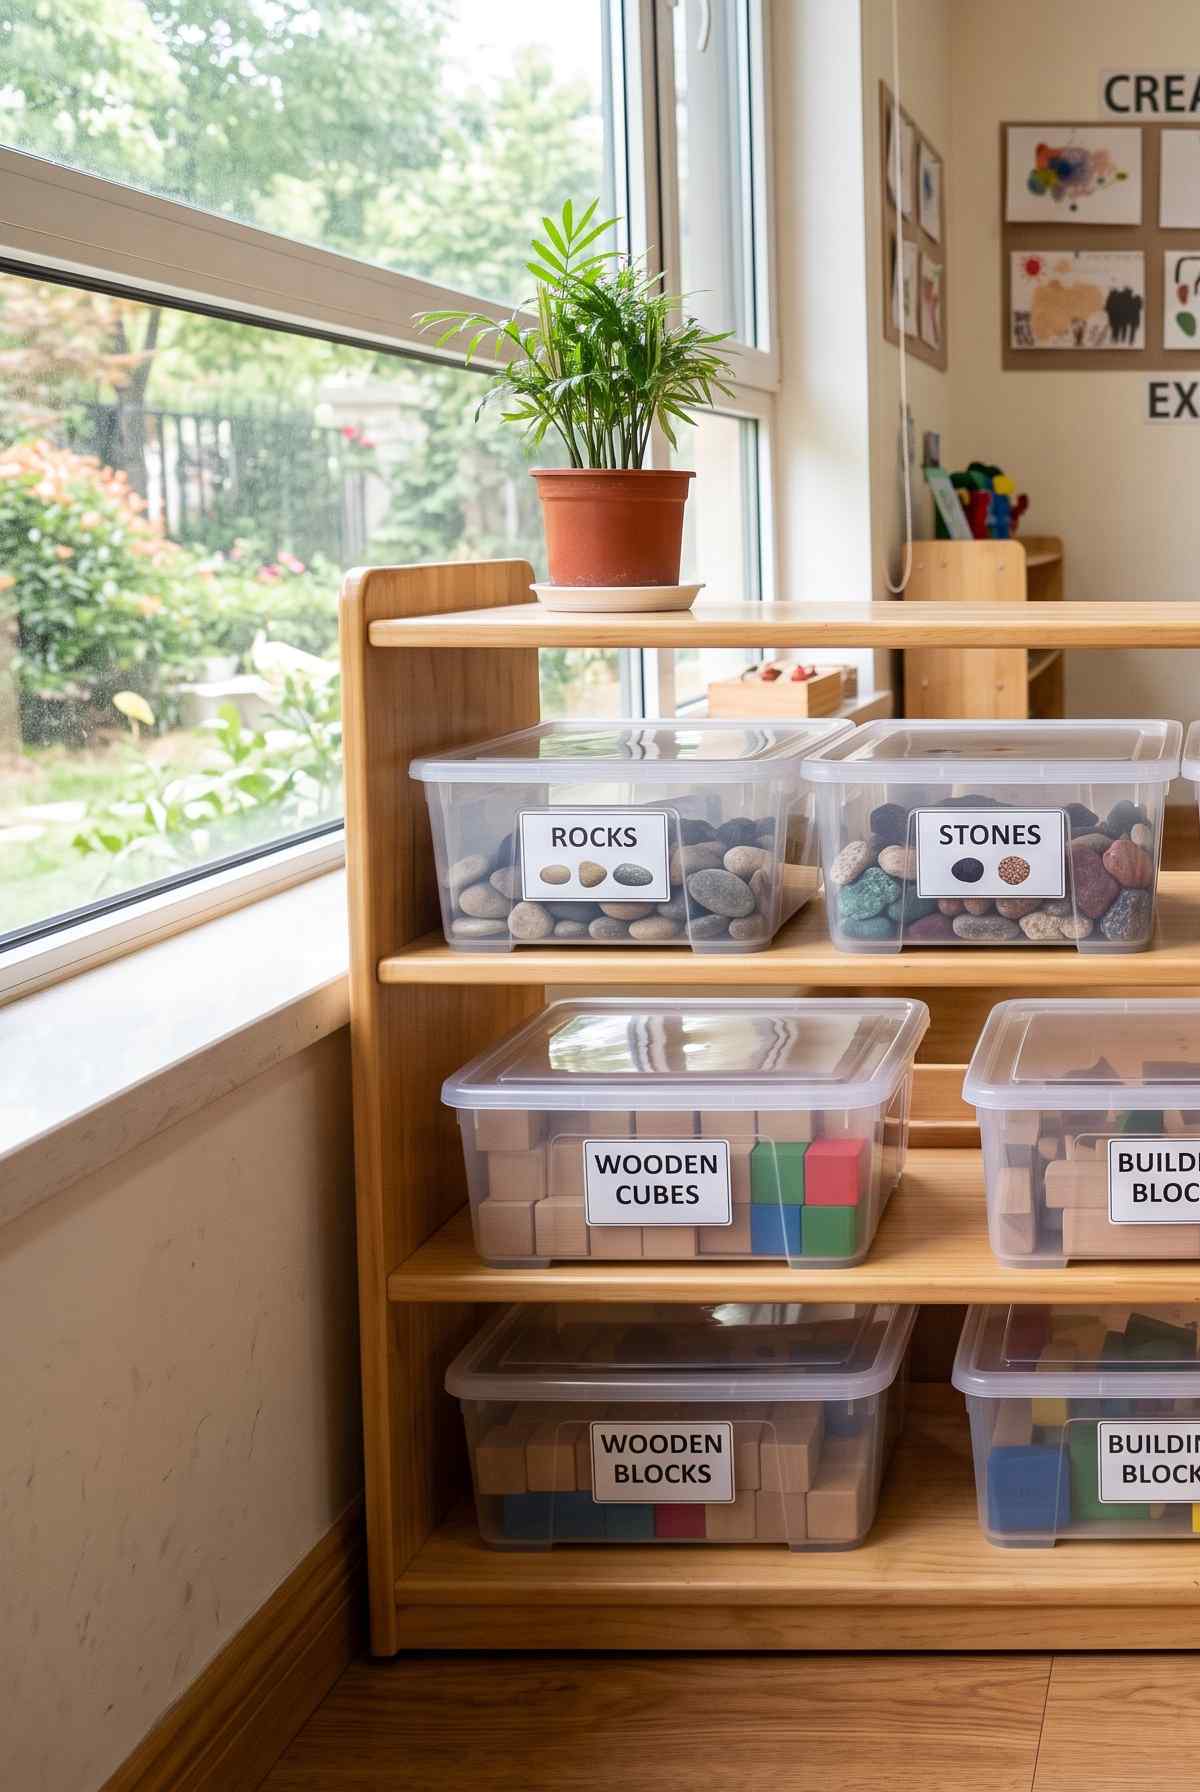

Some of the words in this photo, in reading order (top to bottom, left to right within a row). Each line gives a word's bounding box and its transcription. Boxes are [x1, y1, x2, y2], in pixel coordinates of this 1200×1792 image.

[551, 826, 638, 848] ROCKS
[938, 824, 1042, 846] STONES
[594, 1154, 718, 1175] WOODEN
[615, 1184, 700, 1205] CUBES
[600, 1434, 722, 1455] WOODEN
[614, 1463, 712, 1484] BLOCKS
